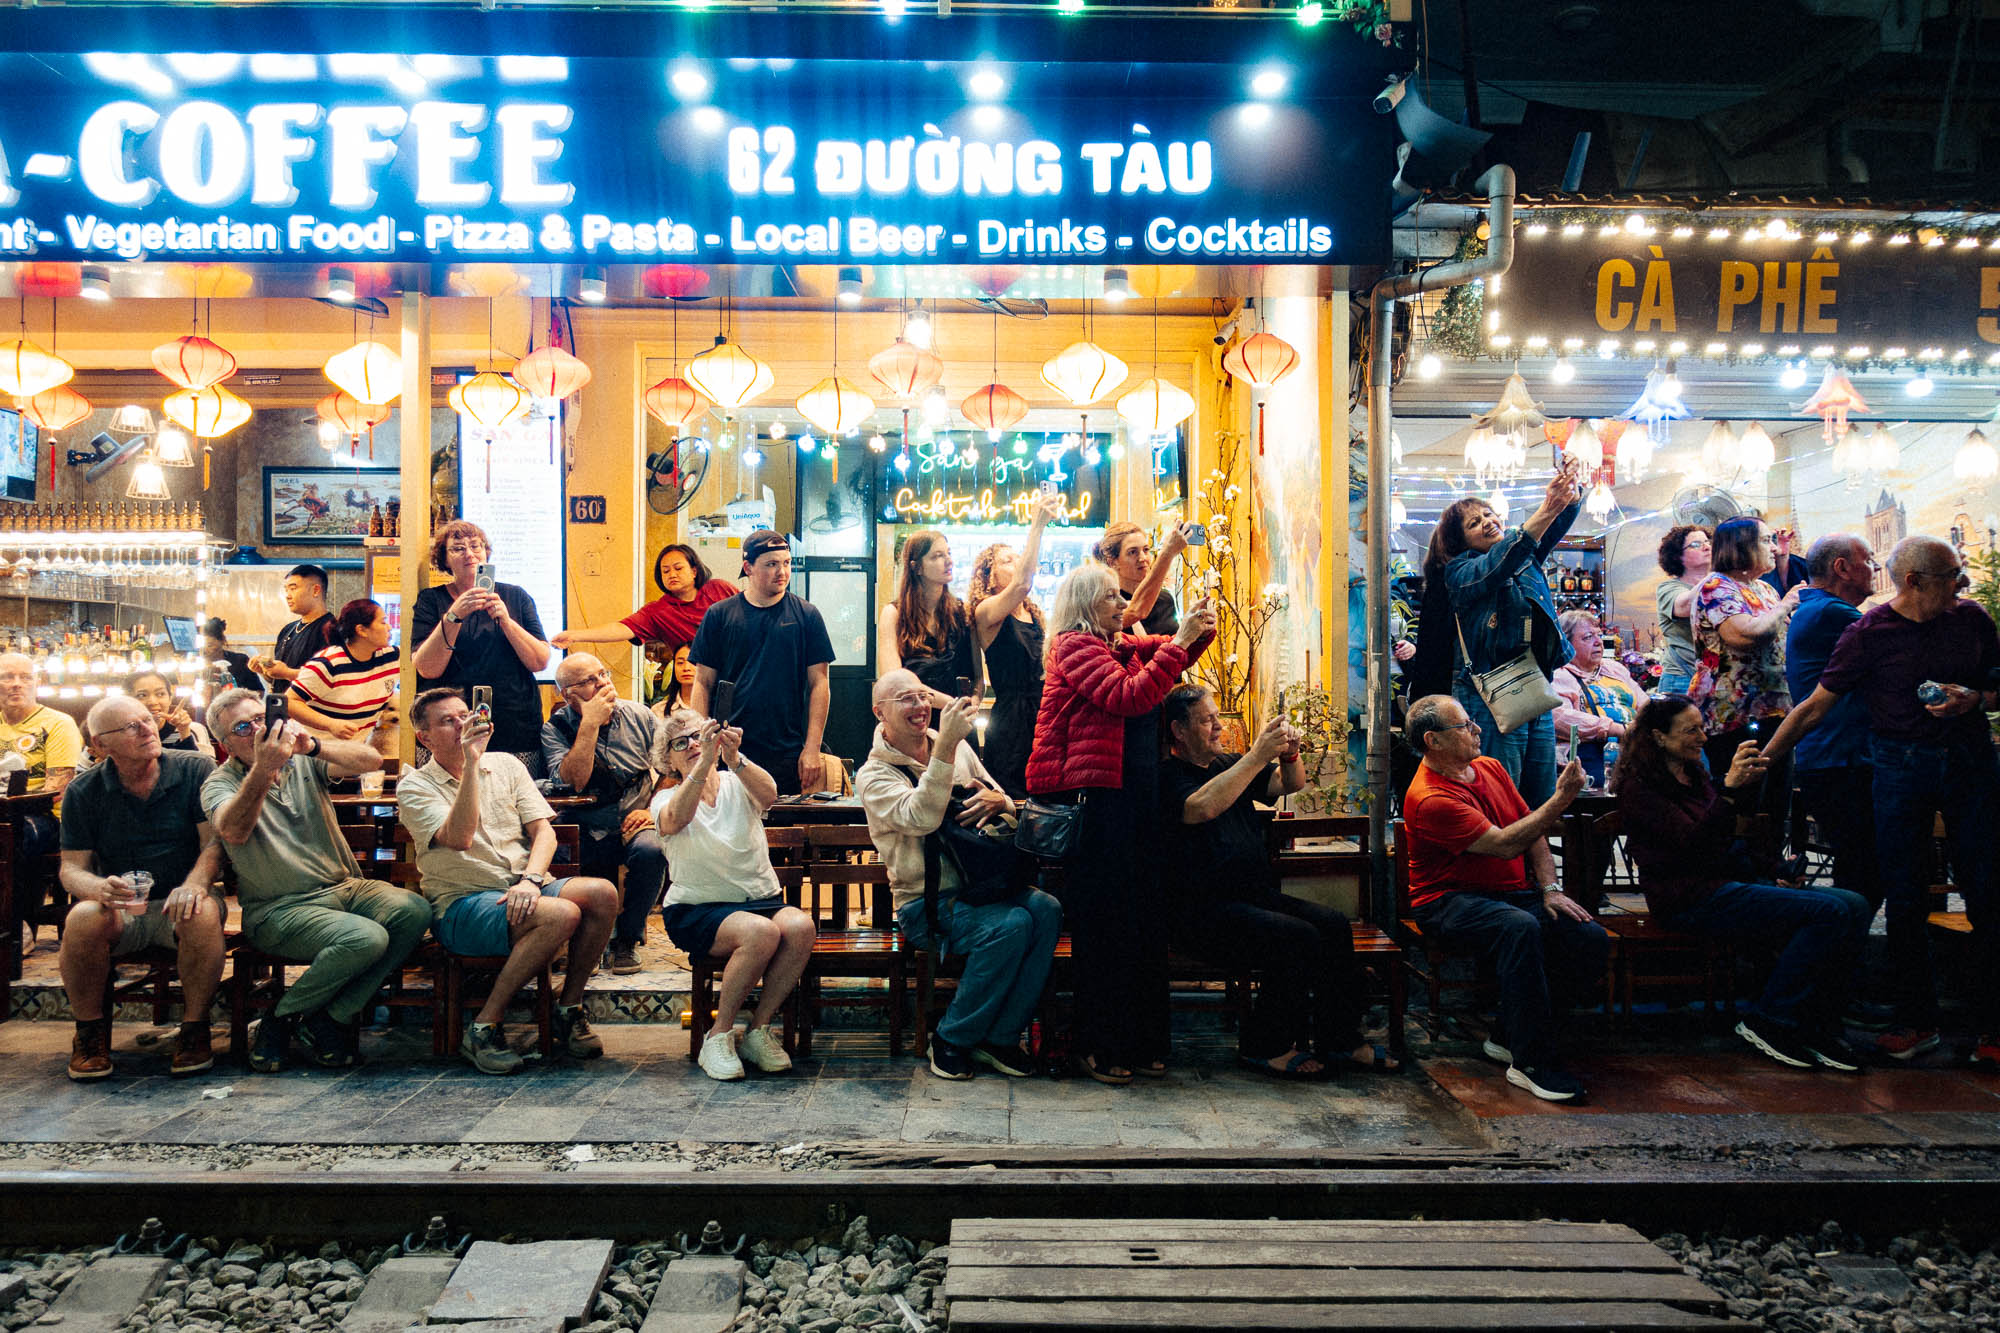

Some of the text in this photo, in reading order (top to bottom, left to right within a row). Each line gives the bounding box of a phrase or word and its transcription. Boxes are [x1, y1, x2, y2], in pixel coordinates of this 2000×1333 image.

[728, 122, 1212, 194] 62 ĐƯỜNG TÀU
[65, 215, 280, 262] Vegetarian
[288, 215, 391, 250] Food
[425, 215, 530, 250] Pizza
[540, 214, 574, 250] &
[583, 214, 696, 251] Pasta
[731, 216, 838, 252] Local
[849, 217, 943, 252] Beer
[979, 218, 1106, 253] Drinks
[1146, 217, 1332, 254] Cocktails
[1594, 245, 1678, 333] CÀ
[1716, 247, 1840, 333] PHÊ
[575, 500, 601, 520] 60
